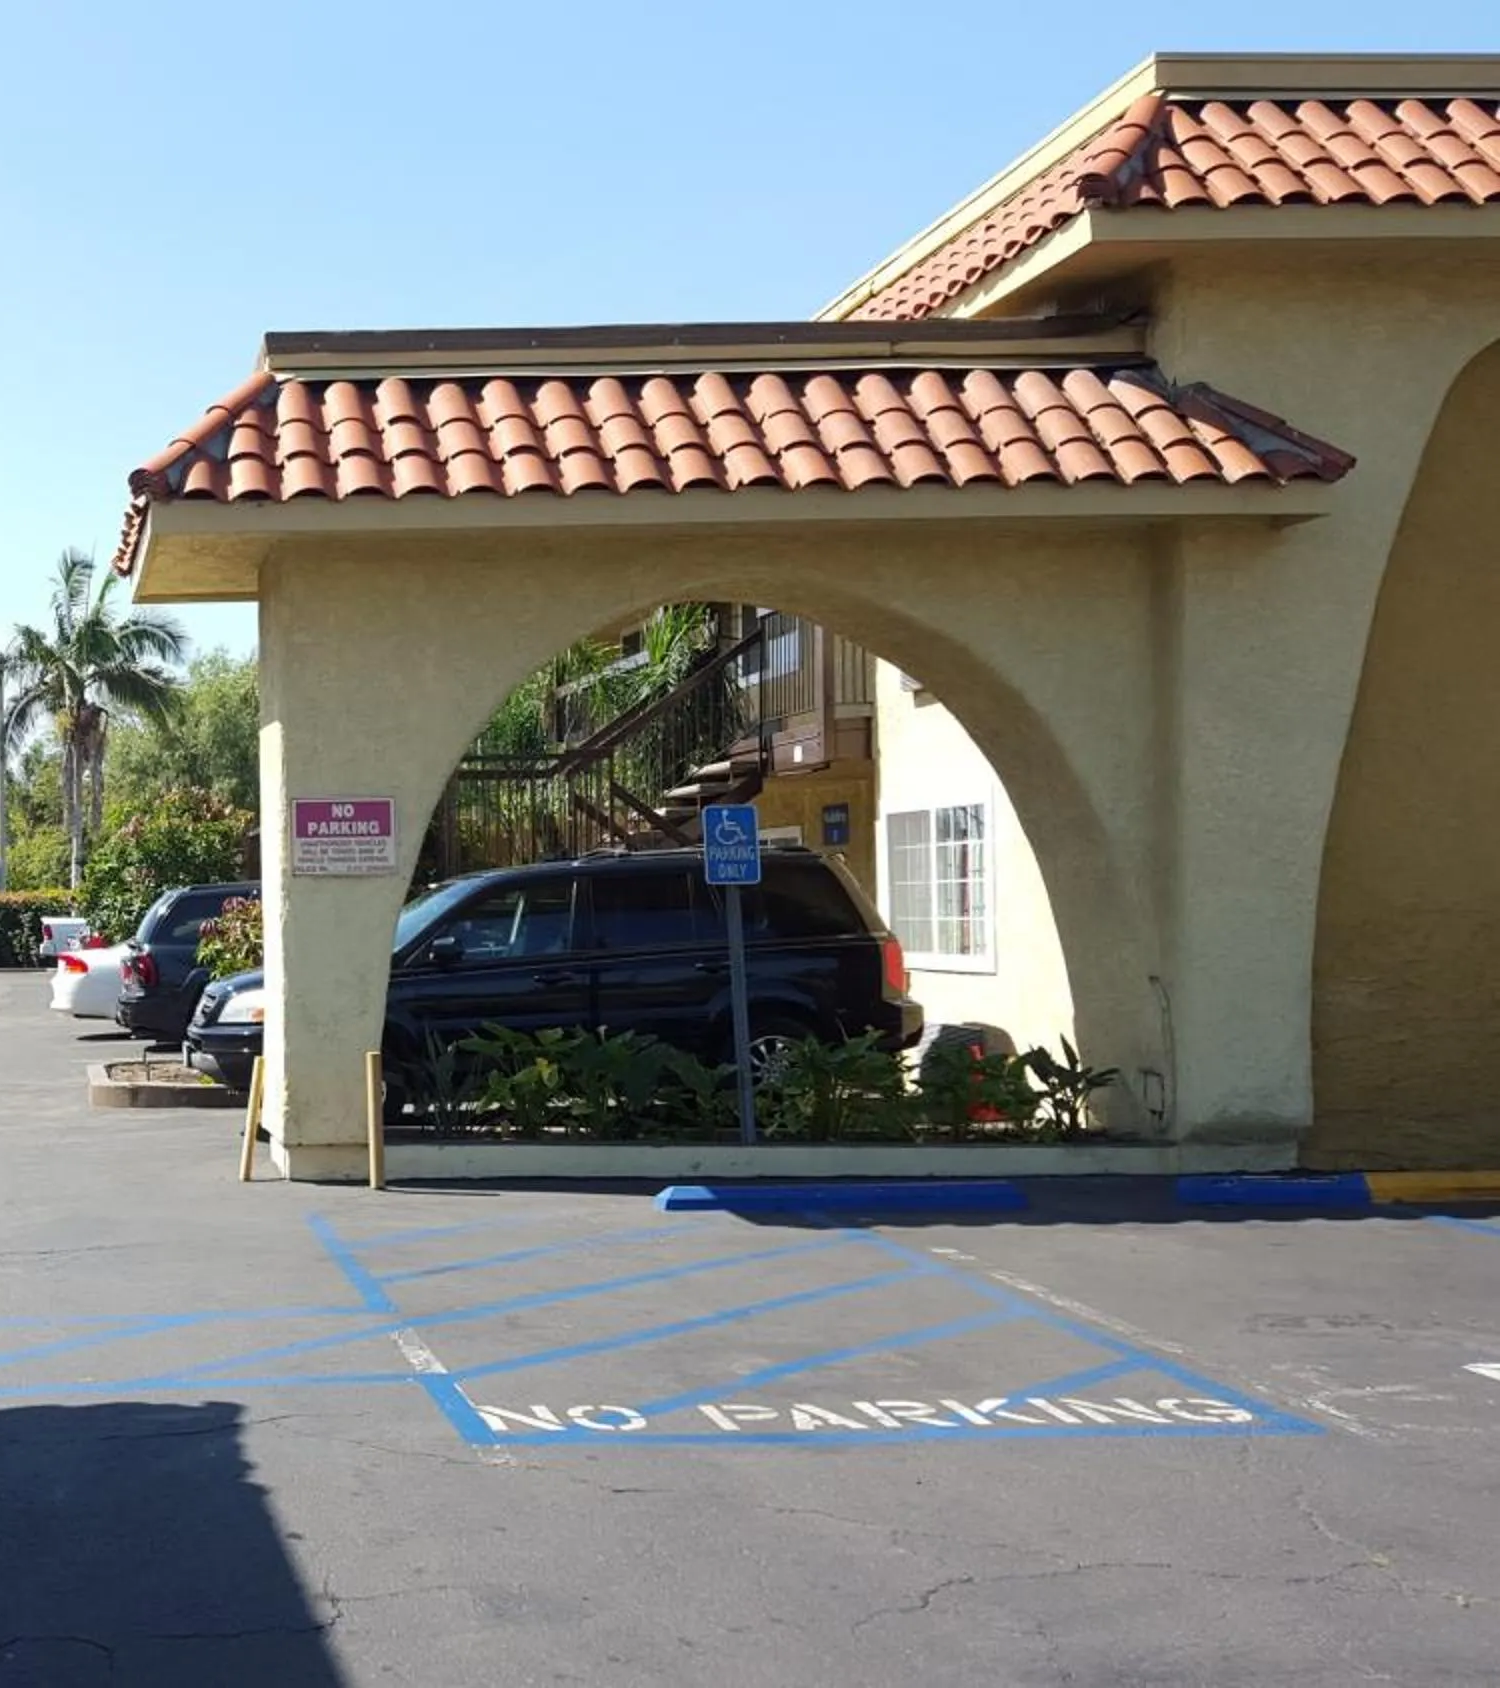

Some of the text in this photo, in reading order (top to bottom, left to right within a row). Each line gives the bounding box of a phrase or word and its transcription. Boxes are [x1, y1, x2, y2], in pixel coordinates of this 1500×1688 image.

[331, 804, 355, 818] NO
[307, 821, 380, 835] PARKING
[709, 846, 755, 861] PARKING
[718, 863, 748, 879] ONLY
[476, 1398, 1253, 1431] NO PARKING
